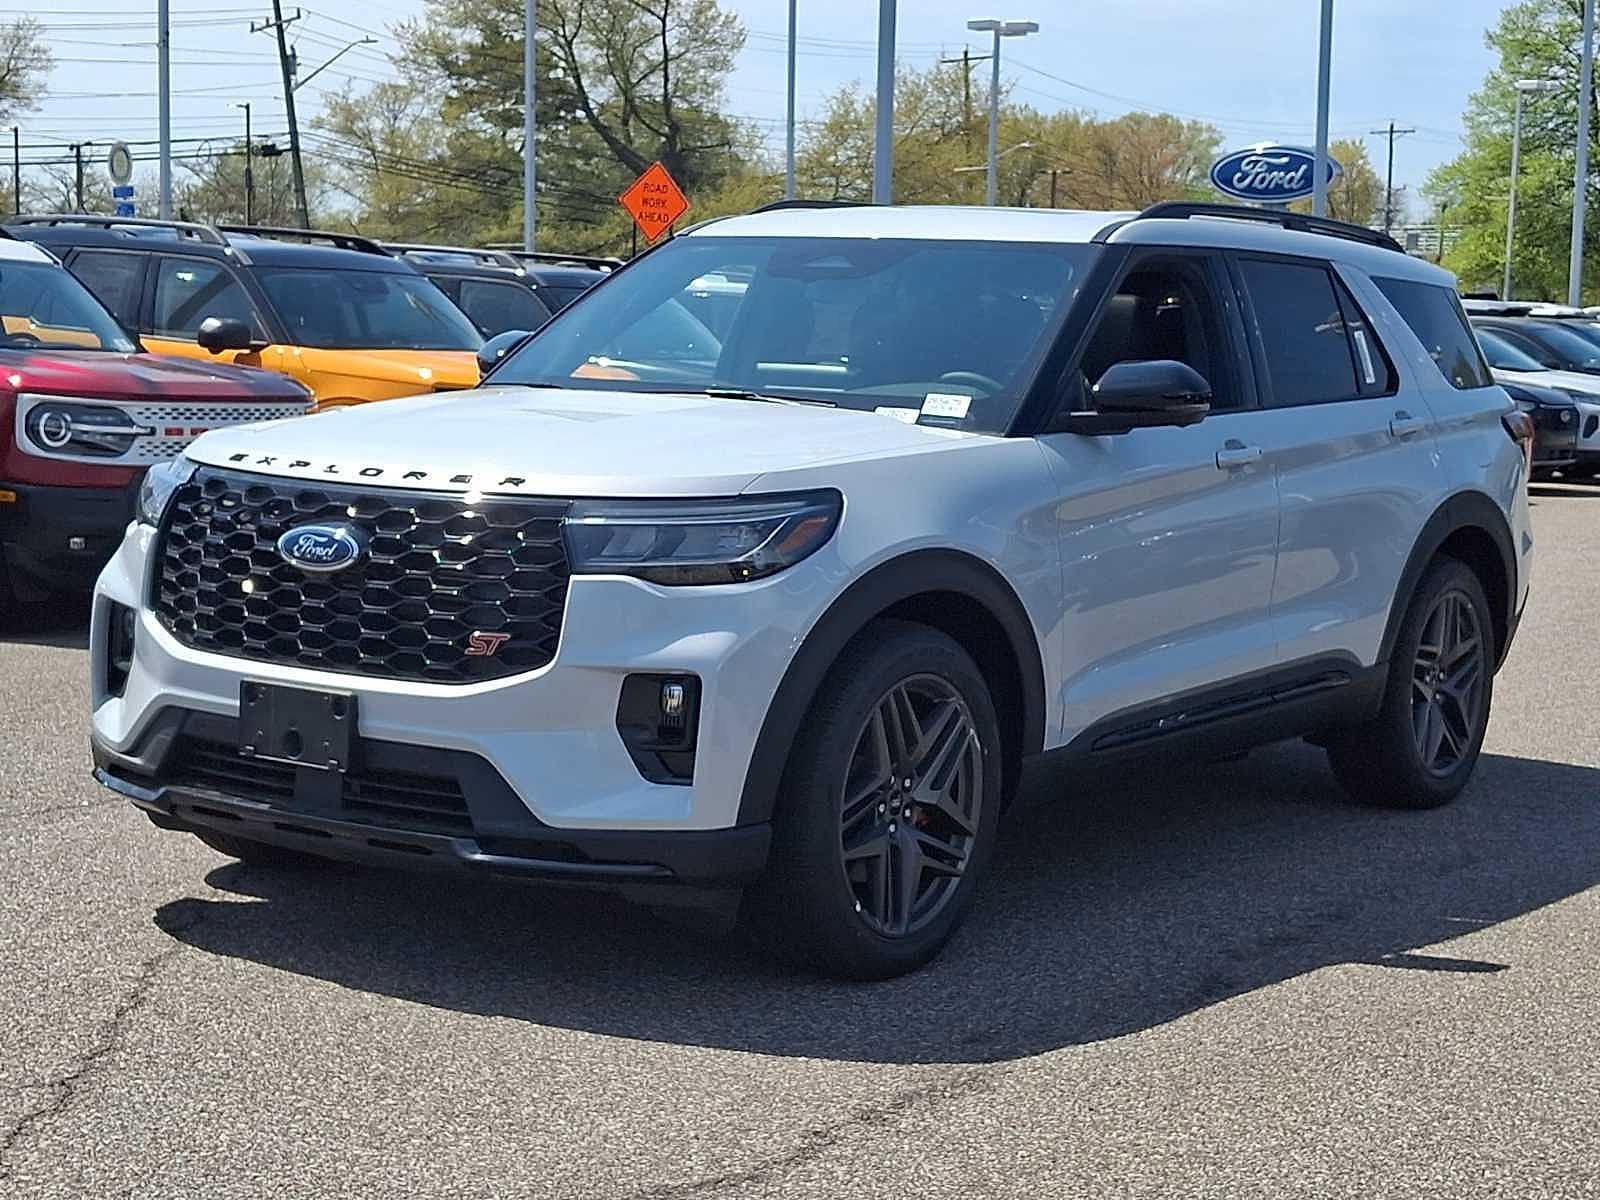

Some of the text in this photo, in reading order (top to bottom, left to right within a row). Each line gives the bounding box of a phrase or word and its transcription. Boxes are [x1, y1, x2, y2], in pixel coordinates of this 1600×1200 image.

[1232, 155, 1308, 190] Ford
[642, 182, 669, 194] ROAD
[641, 198, 667, 208] WORK
[638, 211, 670, 223] AHEAD
[228, 453, 526, 487] EXPLORER
[292, 533, 339, 560] Ford
[464, 630, 511, 656] ST
